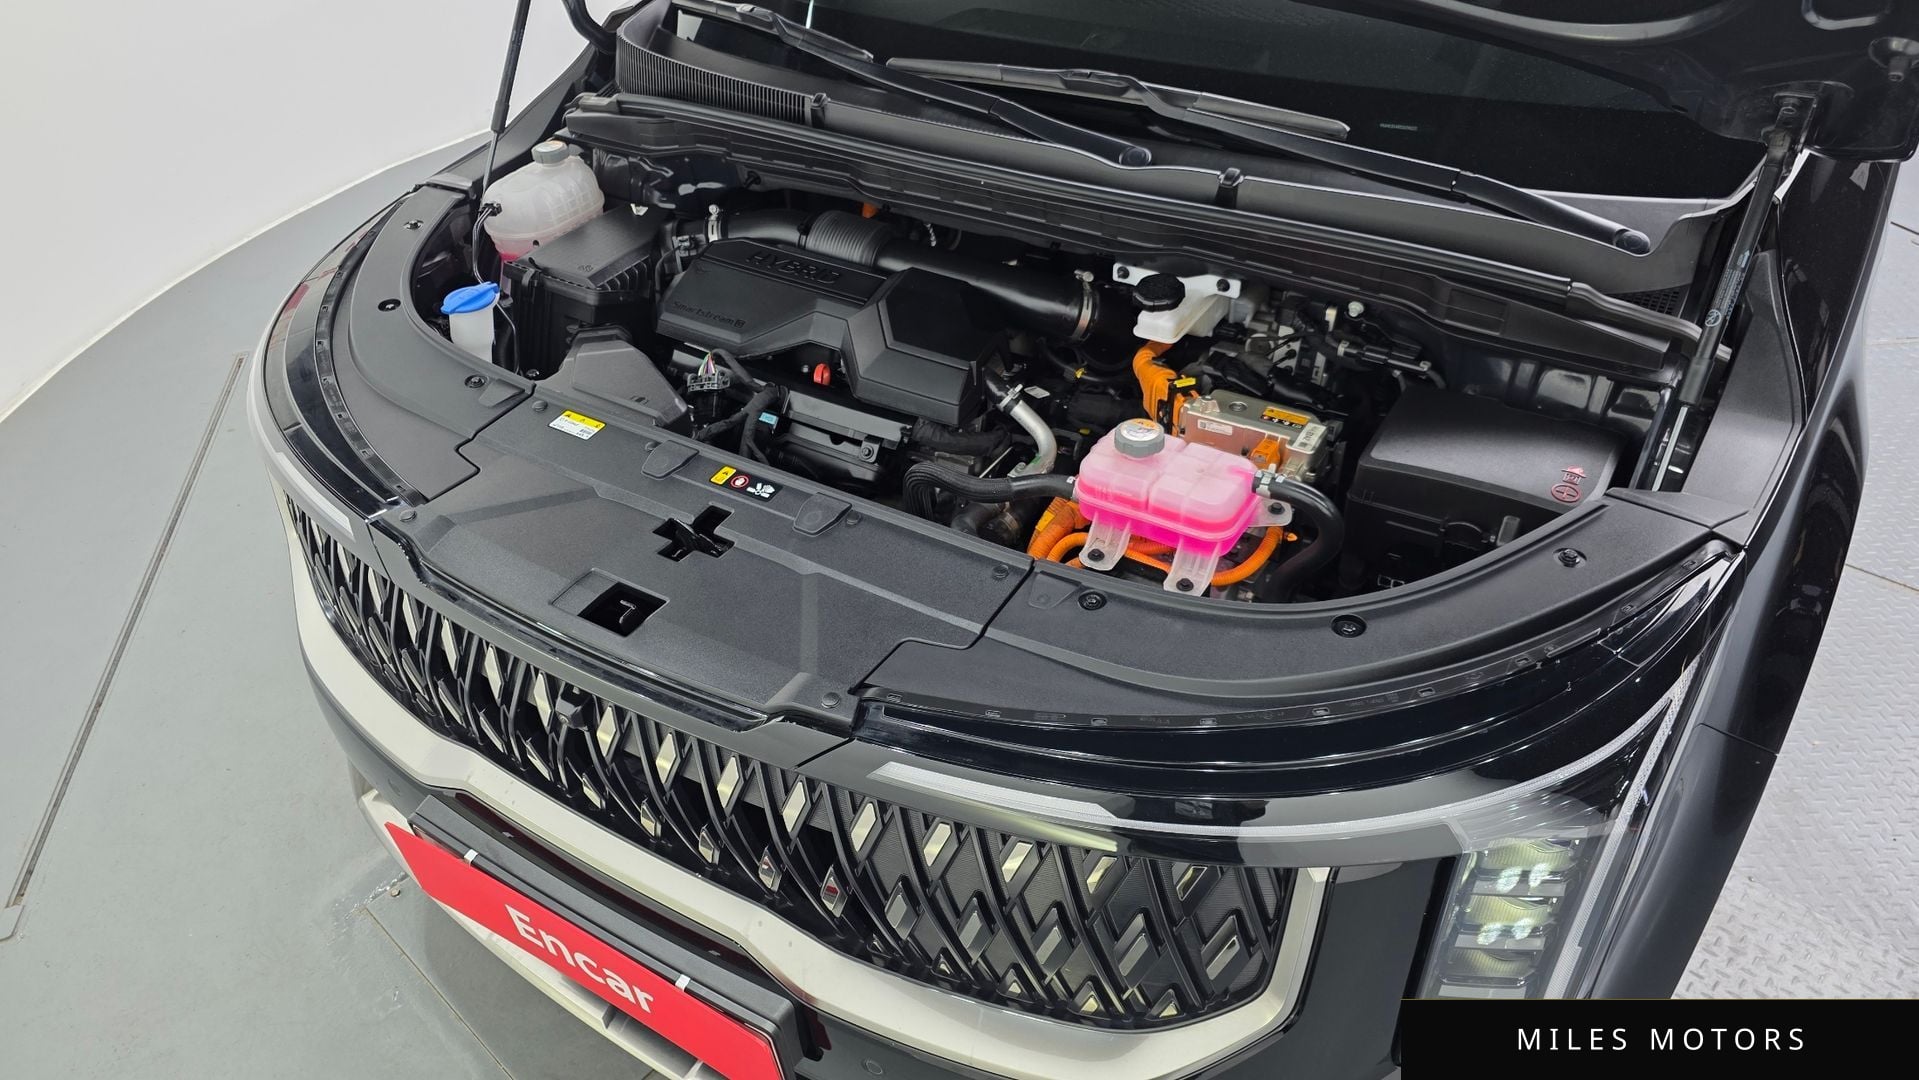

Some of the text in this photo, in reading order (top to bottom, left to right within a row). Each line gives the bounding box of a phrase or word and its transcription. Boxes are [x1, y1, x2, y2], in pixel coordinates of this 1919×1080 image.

[746, 251, 840, 284] HYBRID
[672, 301, 735, 326] Smartstream
[505, 904, 654, 1014] Encar
